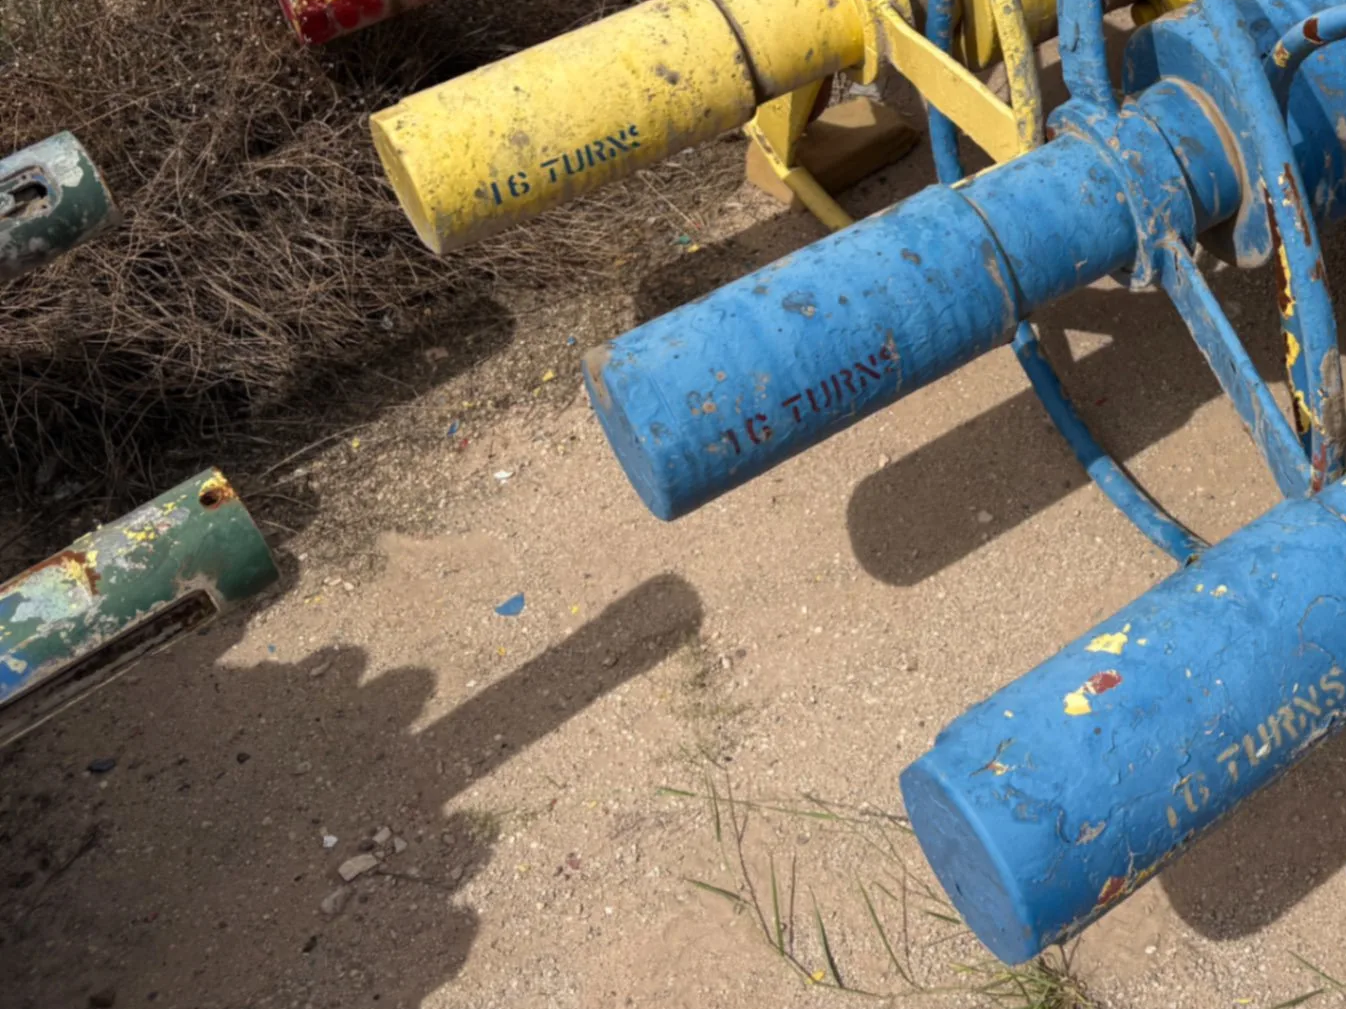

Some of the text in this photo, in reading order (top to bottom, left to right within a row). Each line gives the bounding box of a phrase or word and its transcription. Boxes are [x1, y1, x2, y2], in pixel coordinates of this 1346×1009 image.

[490, 125, 641, 205] 16 TURNS
[725, 345, 898, 455] 16 TURNS
[1216, 664, 1346, 784] TURNS
